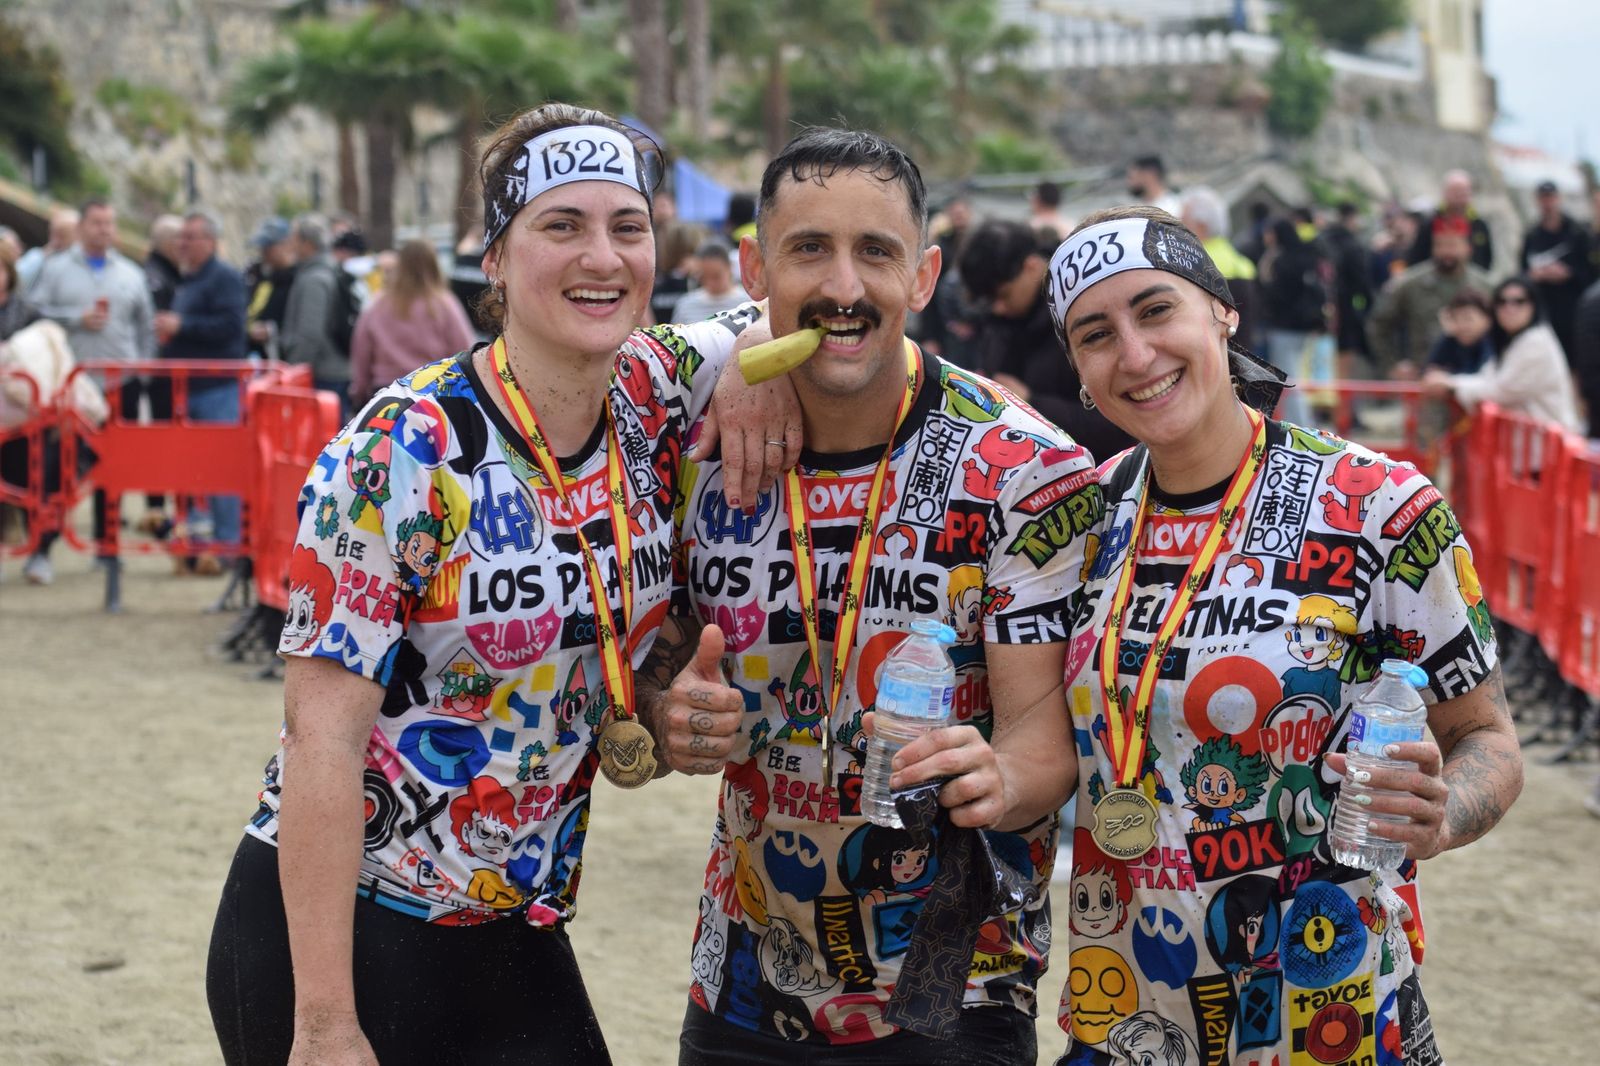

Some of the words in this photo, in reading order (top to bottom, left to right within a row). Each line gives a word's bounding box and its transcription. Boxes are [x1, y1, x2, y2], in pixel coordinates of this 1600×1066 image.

[541, 139, 624, 181] 1322
[1056, 231, 1125, 300] 1323
[1171, 253, 1193, 270] 300
[1029, 487, 1058, 509] MUT
[1391, 504, 1416, 533] MUT
[1247, 526, 1301, 557] POX
[340, 561, 398, 608] BOLE
[469, 565, 545, 615] LOS
[690, 556, 754, 598] LOS
[772, 773, 839, 804] BOLE
[1118, 794, 1146, 808] DESAFIO
[774, 795, 839, 823] TIAM
[1192, 822, 1284, 878] 90K
